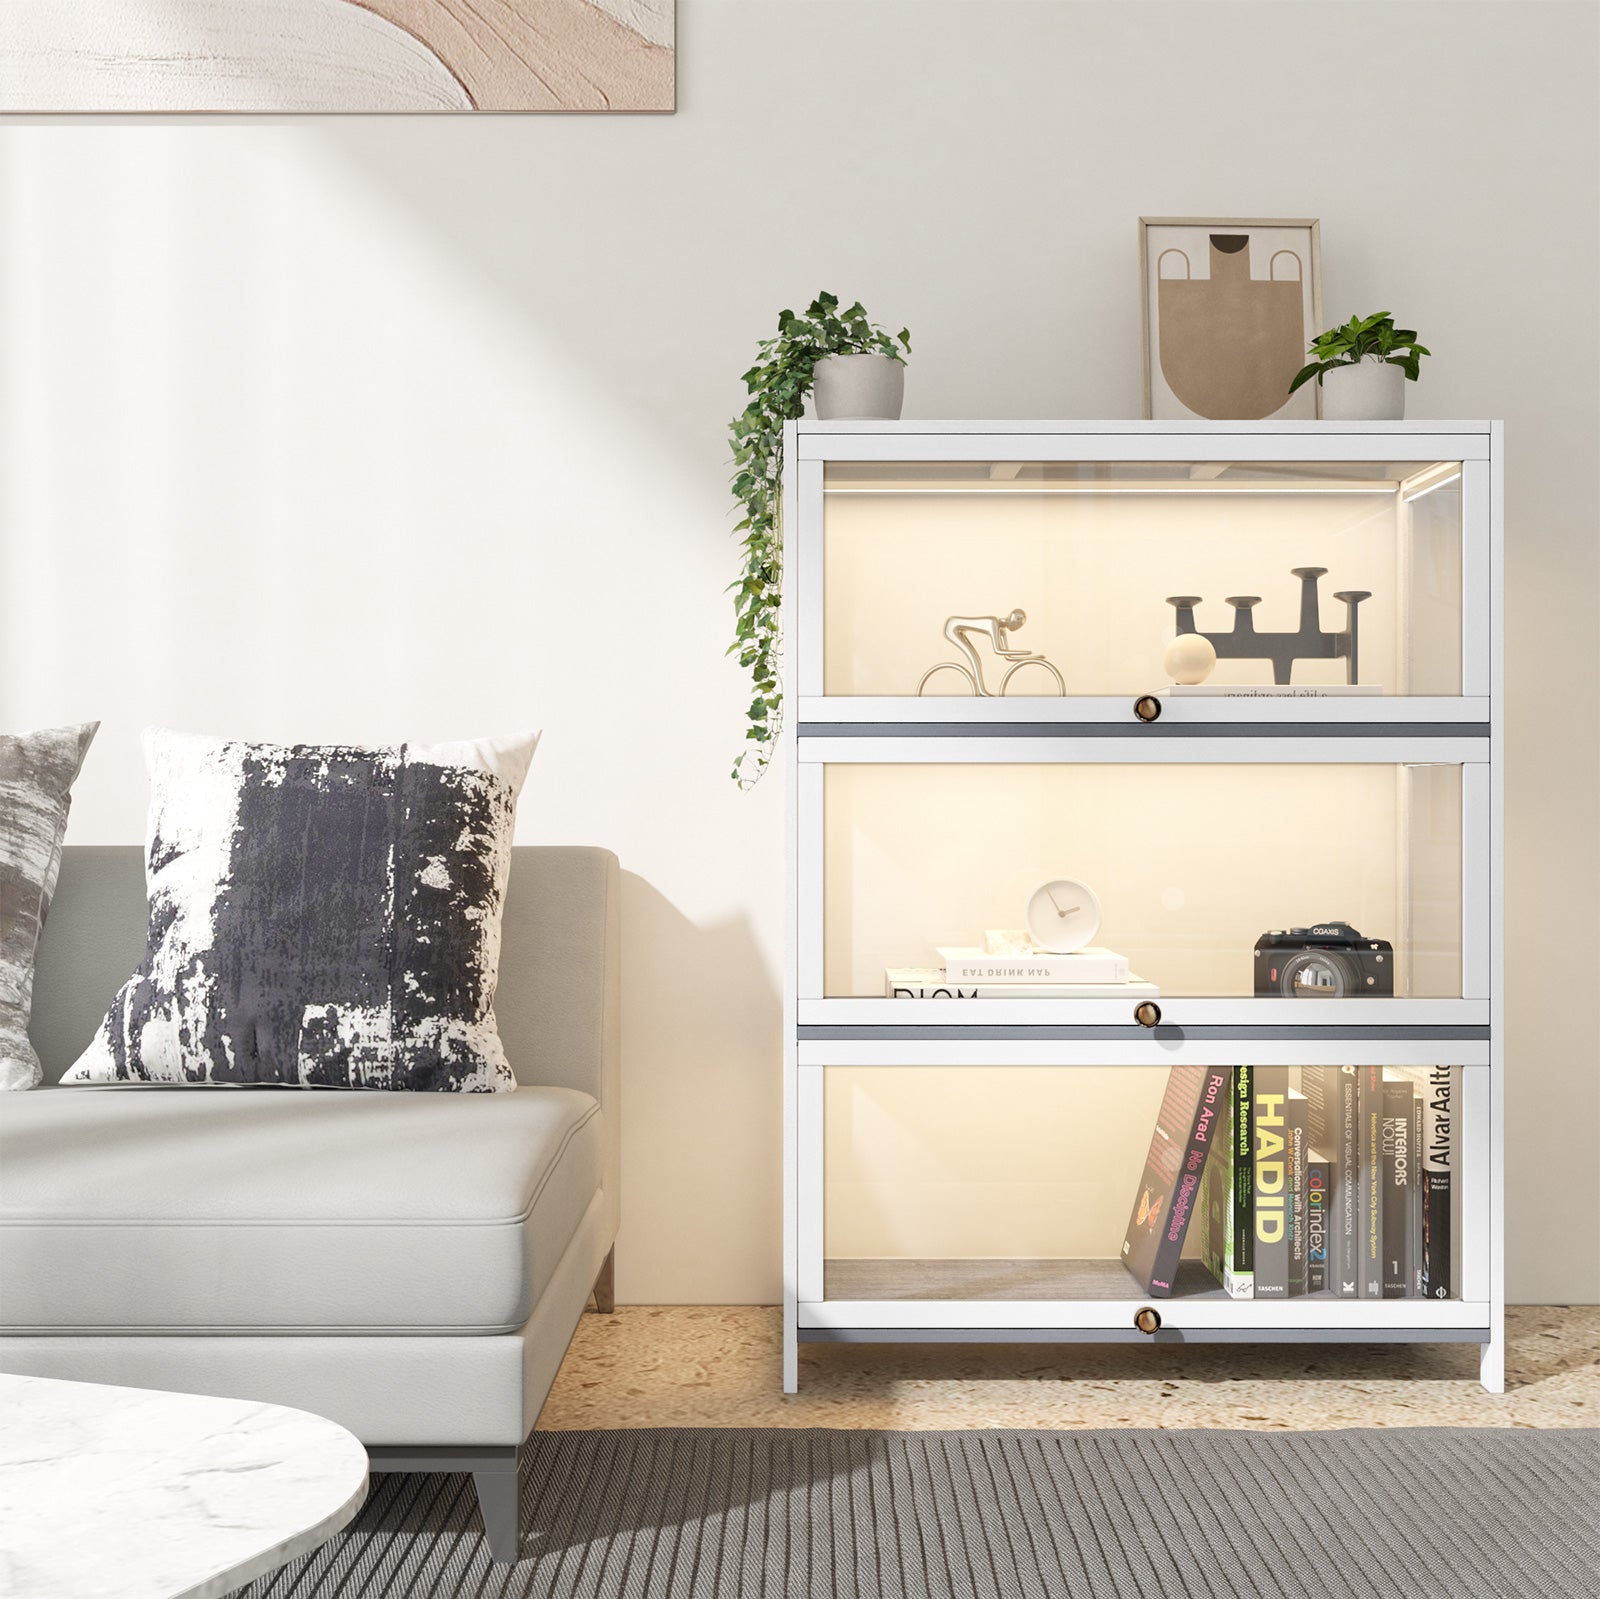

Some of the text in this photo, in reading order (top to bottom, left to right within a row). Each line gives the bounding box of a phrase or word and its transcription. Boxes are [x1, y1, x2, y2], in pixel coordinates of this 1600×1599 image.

[1237, 1064, 1250, 1099] esign
[1344, 1083, 1353, 1129] ESSENTIALS
[1239, 1101, 1250, 1156] Research
[1344, 1130, 1353, 1139] OF
[1382, 1117, 1395, 1155] NOW!
[1394, 1118, 1407, 1185] INTERIORS
[1429, 1115, 1450, 1166] Alvar
[1167, 1074, 1224, 1242] Ron Arad No Discipline
[1256, 1094, 1284, 1243] HADID
[1344, 1142, 1353, 1168] VISUAL
[1293, 1127, 1303, 1261] Conversations with Architects
[1344, 1170, 1353, 1236] COMMUNICATION
[1392, 1260, 1398, 1275] 1
